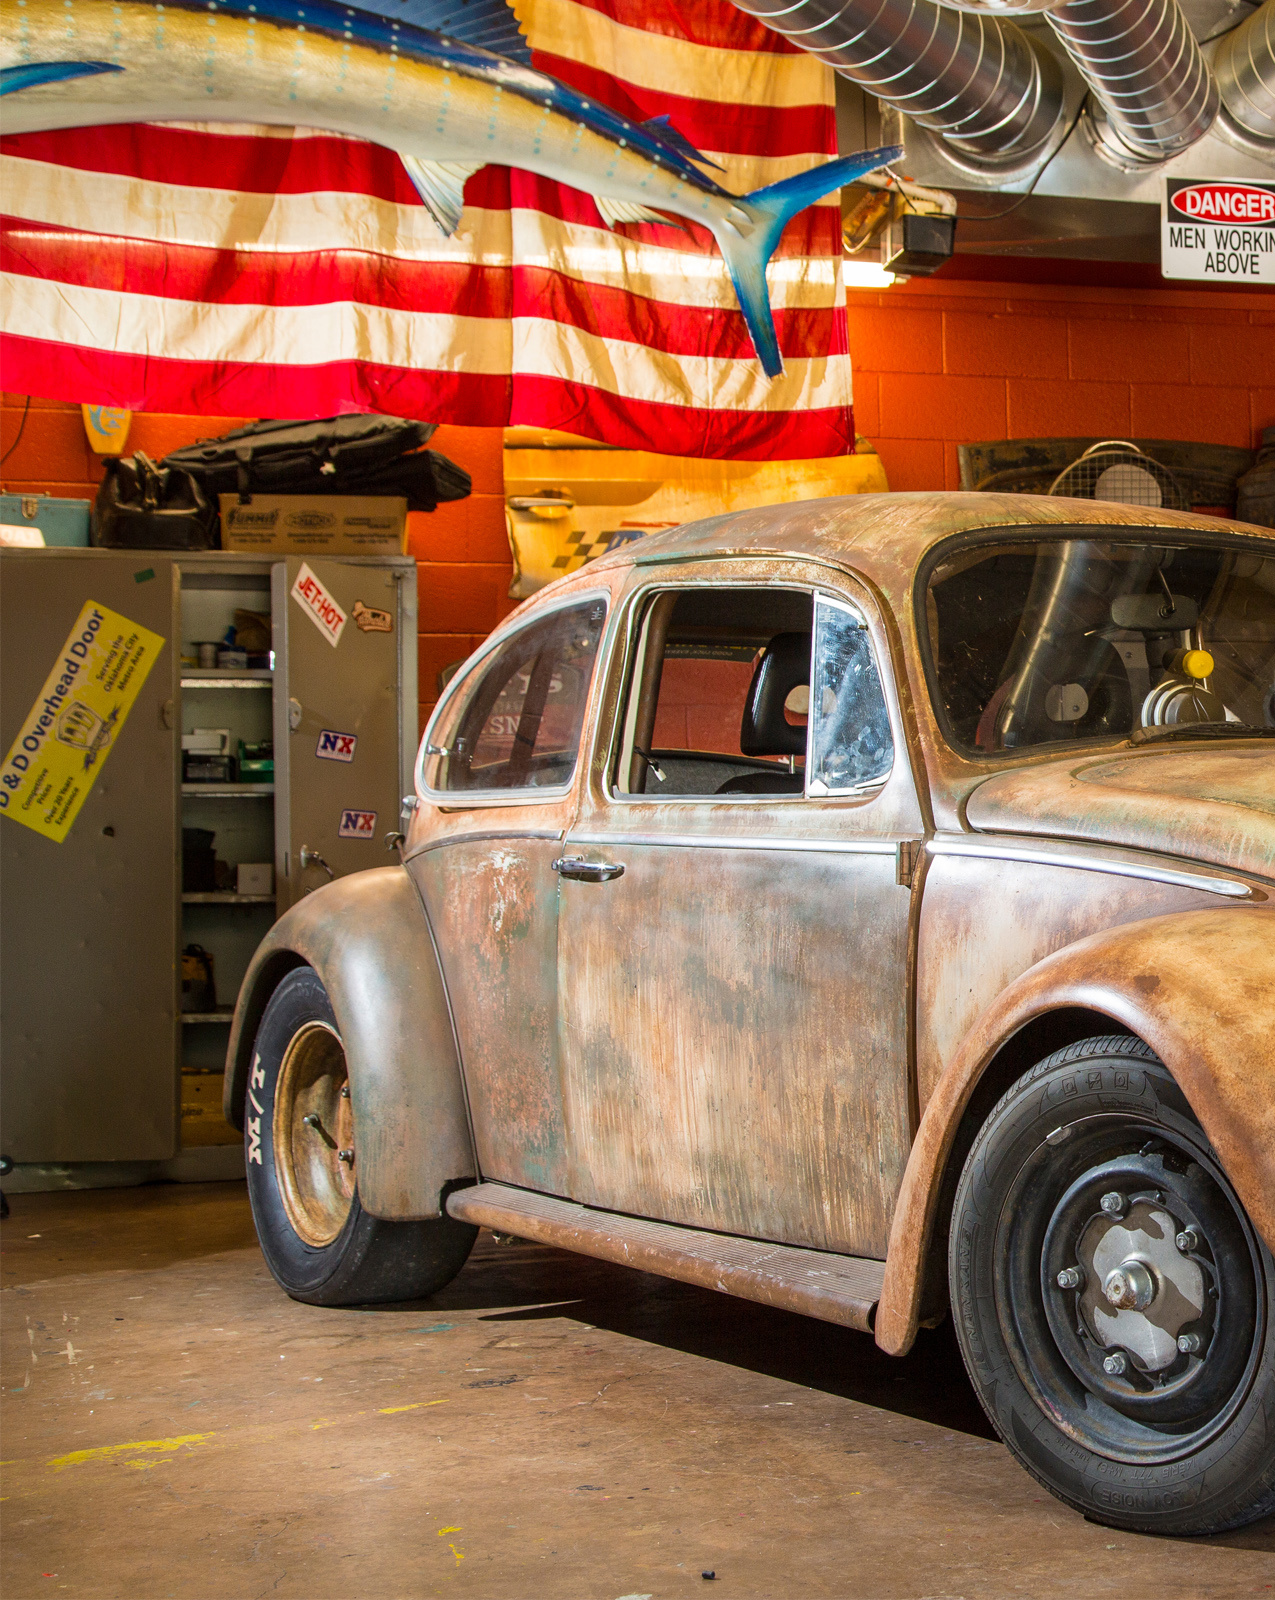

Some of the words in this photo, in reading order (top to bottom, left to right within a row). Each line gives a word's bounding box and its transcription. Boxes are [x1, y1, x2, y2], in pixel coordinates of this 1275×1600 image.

[1185, 190, 1275, 218] DANGER
[1169, 226, 1205, 249] MEN
[1204, 251, 1260, 275] ABOVE
[298, 576, 344, 634] JET-HOT
[70, 609, 104, 659] Door
[95, 649, 118, 682] Serving
[112, 634, 125, 650] the
[103, 650, 129, 692] Oklahoma
[124, 632, 140, 651] City
[116, 665, 134, 692] Metro
[131, 645, 146, 666] Area
[22, 657, 80, 752] Overhead
[321, 733, 354, 754] NX
[11, 754, 29, 772] D
[2, 773, 21, 790] &
[21, 767, 49, 811] Competitive
[36, 783, 53, 805] Prices
[44, 805, 58, 824] Over
[55, 786, 79, 826] Experience
[343, 813, 375, 831] NX
[1131, 1468, 1154, 1481] 77T
[1100, 1488, 1146, 1507] NOISE
[1153, 1488, 1184, 1507] LOW
